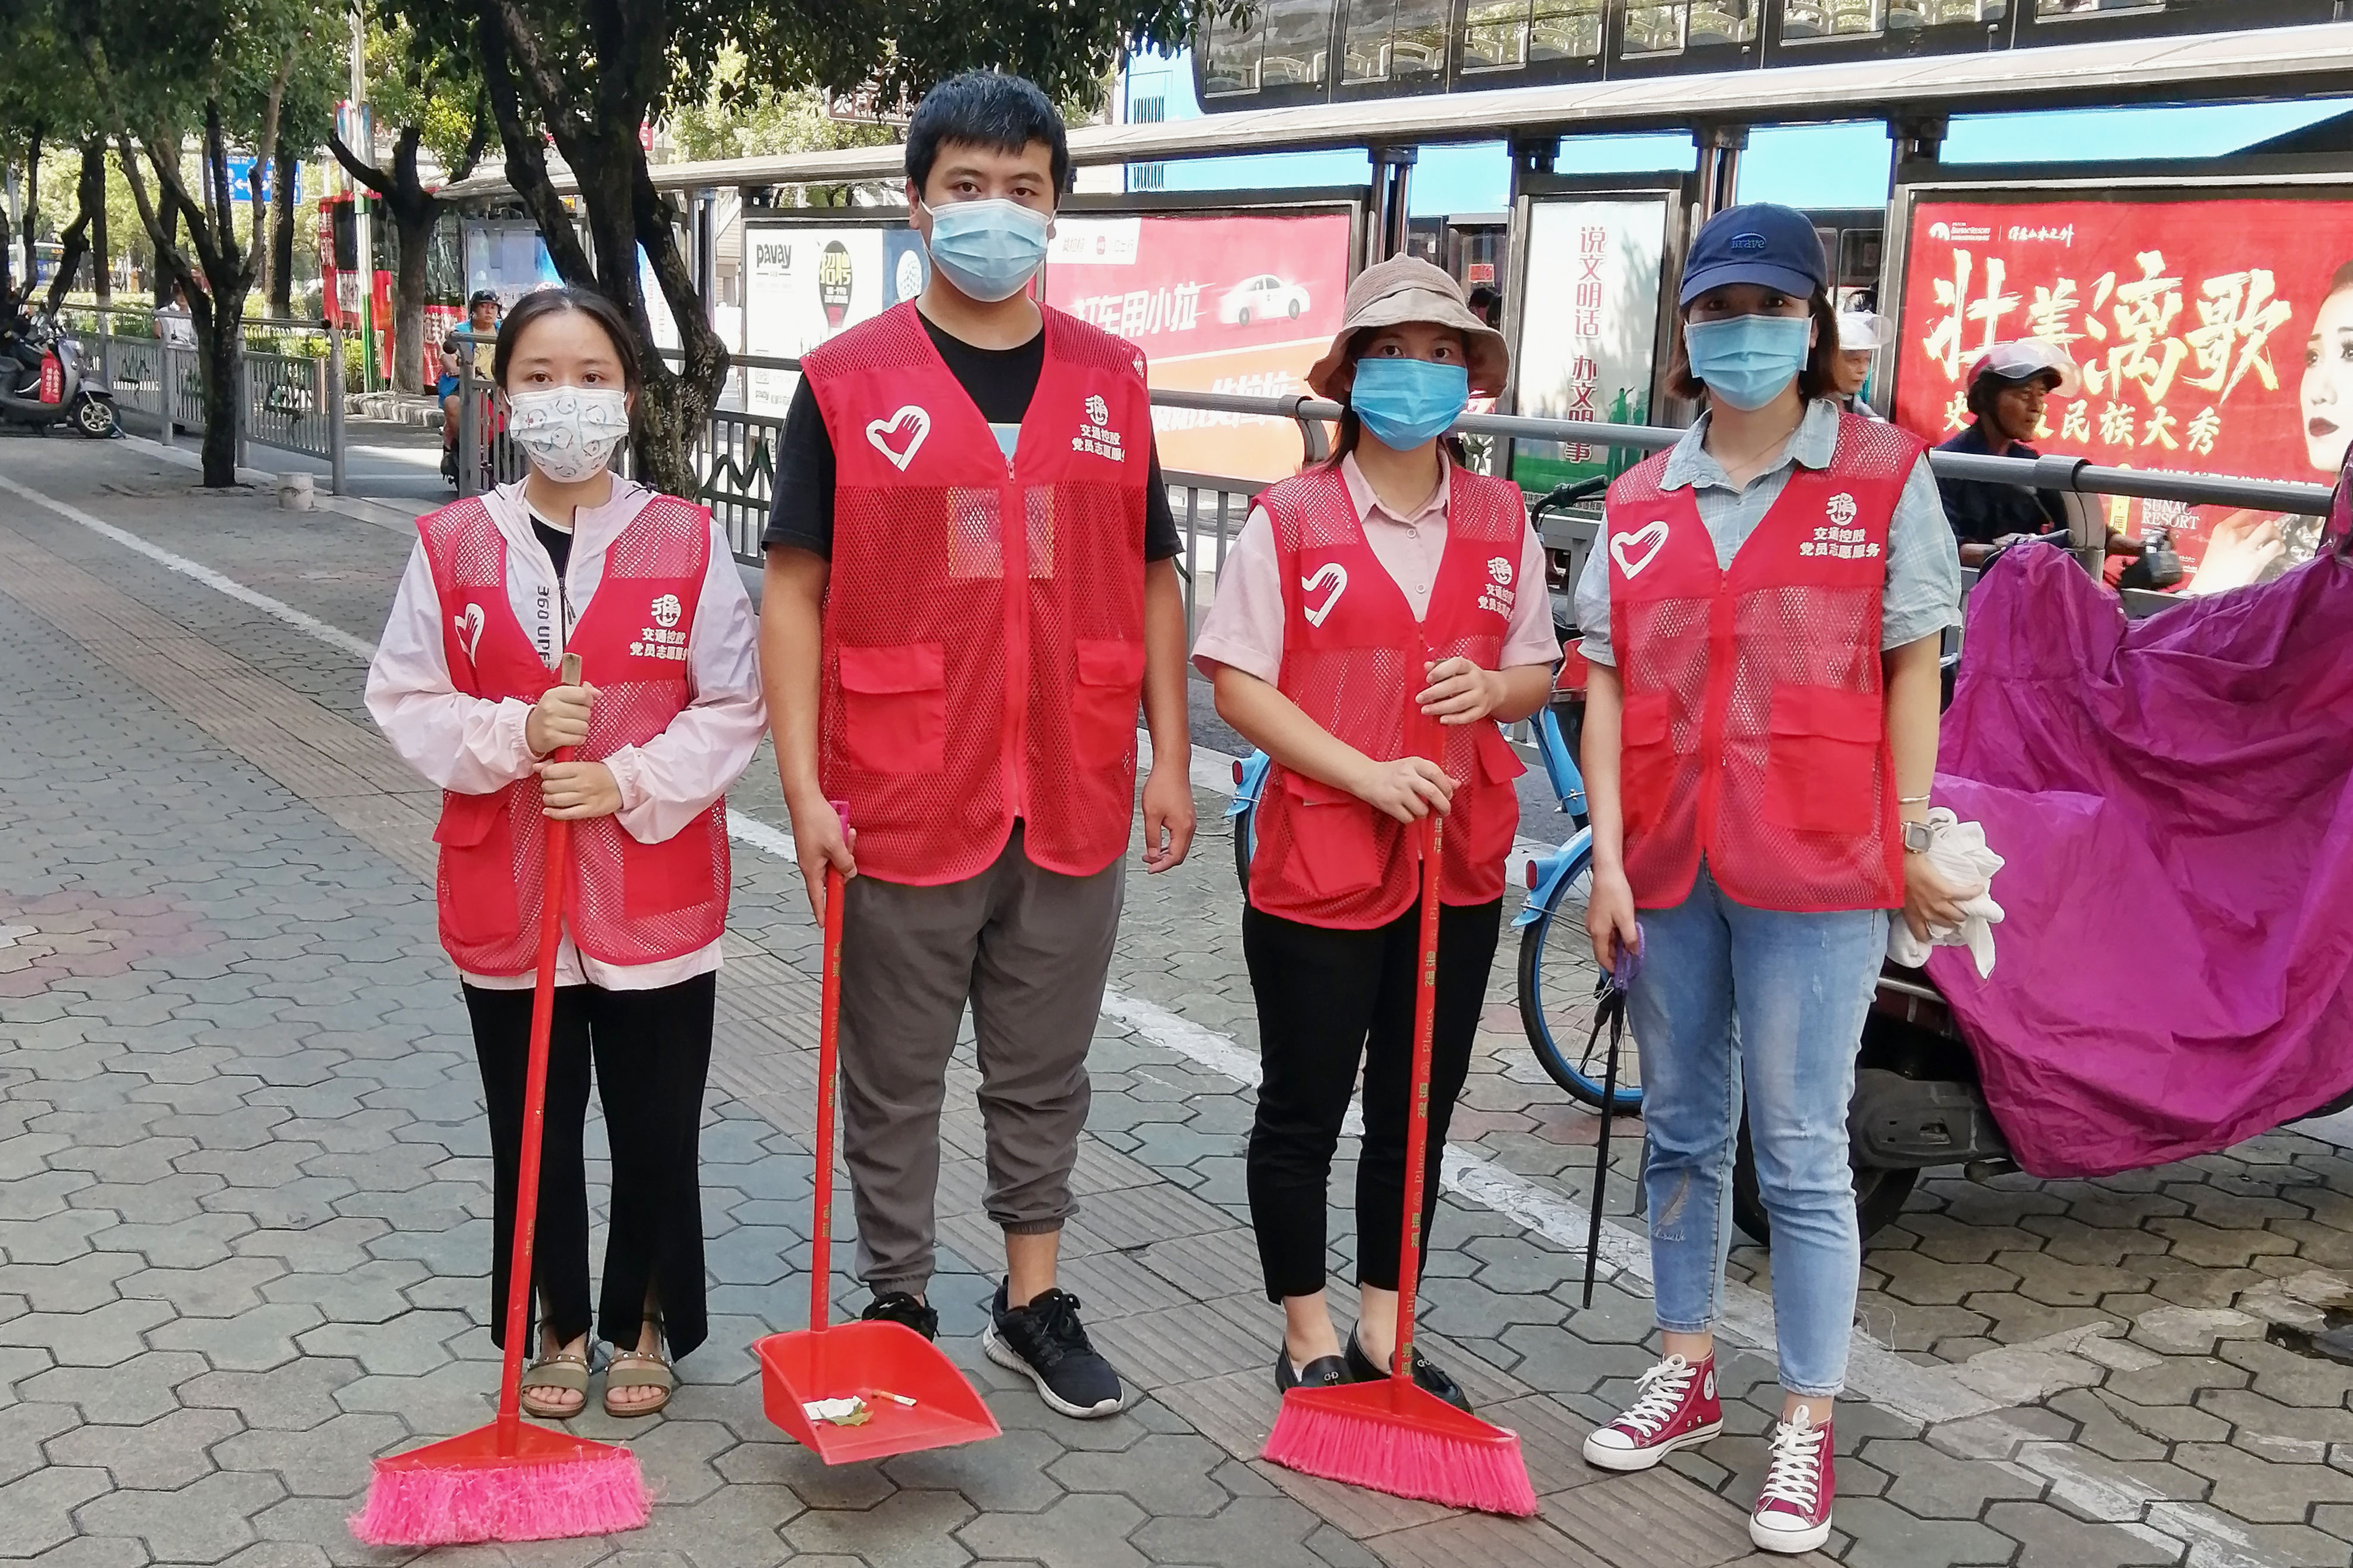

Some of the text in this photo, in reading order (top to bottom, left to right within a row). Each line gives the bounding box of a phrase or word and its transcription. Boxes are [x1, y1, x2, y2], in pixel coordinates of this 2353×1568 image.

[1575, 226, 1606, 337] 说文明话
[1074, 281, 1202, 338] 打车用小拉
[1923, 248, 2292, 406] 壮美漓歌
[1943, 390, 2221, 456] 史民族大秀
[1813, 527, 1866, 543] 交通控股
[2141, 510, 2200, 529] RESORT
[1799, 541, 1881, 559] 党员志愿服务
[537, 586, 550, 619] 360
[641, 626, 687, 645] 交通控股
